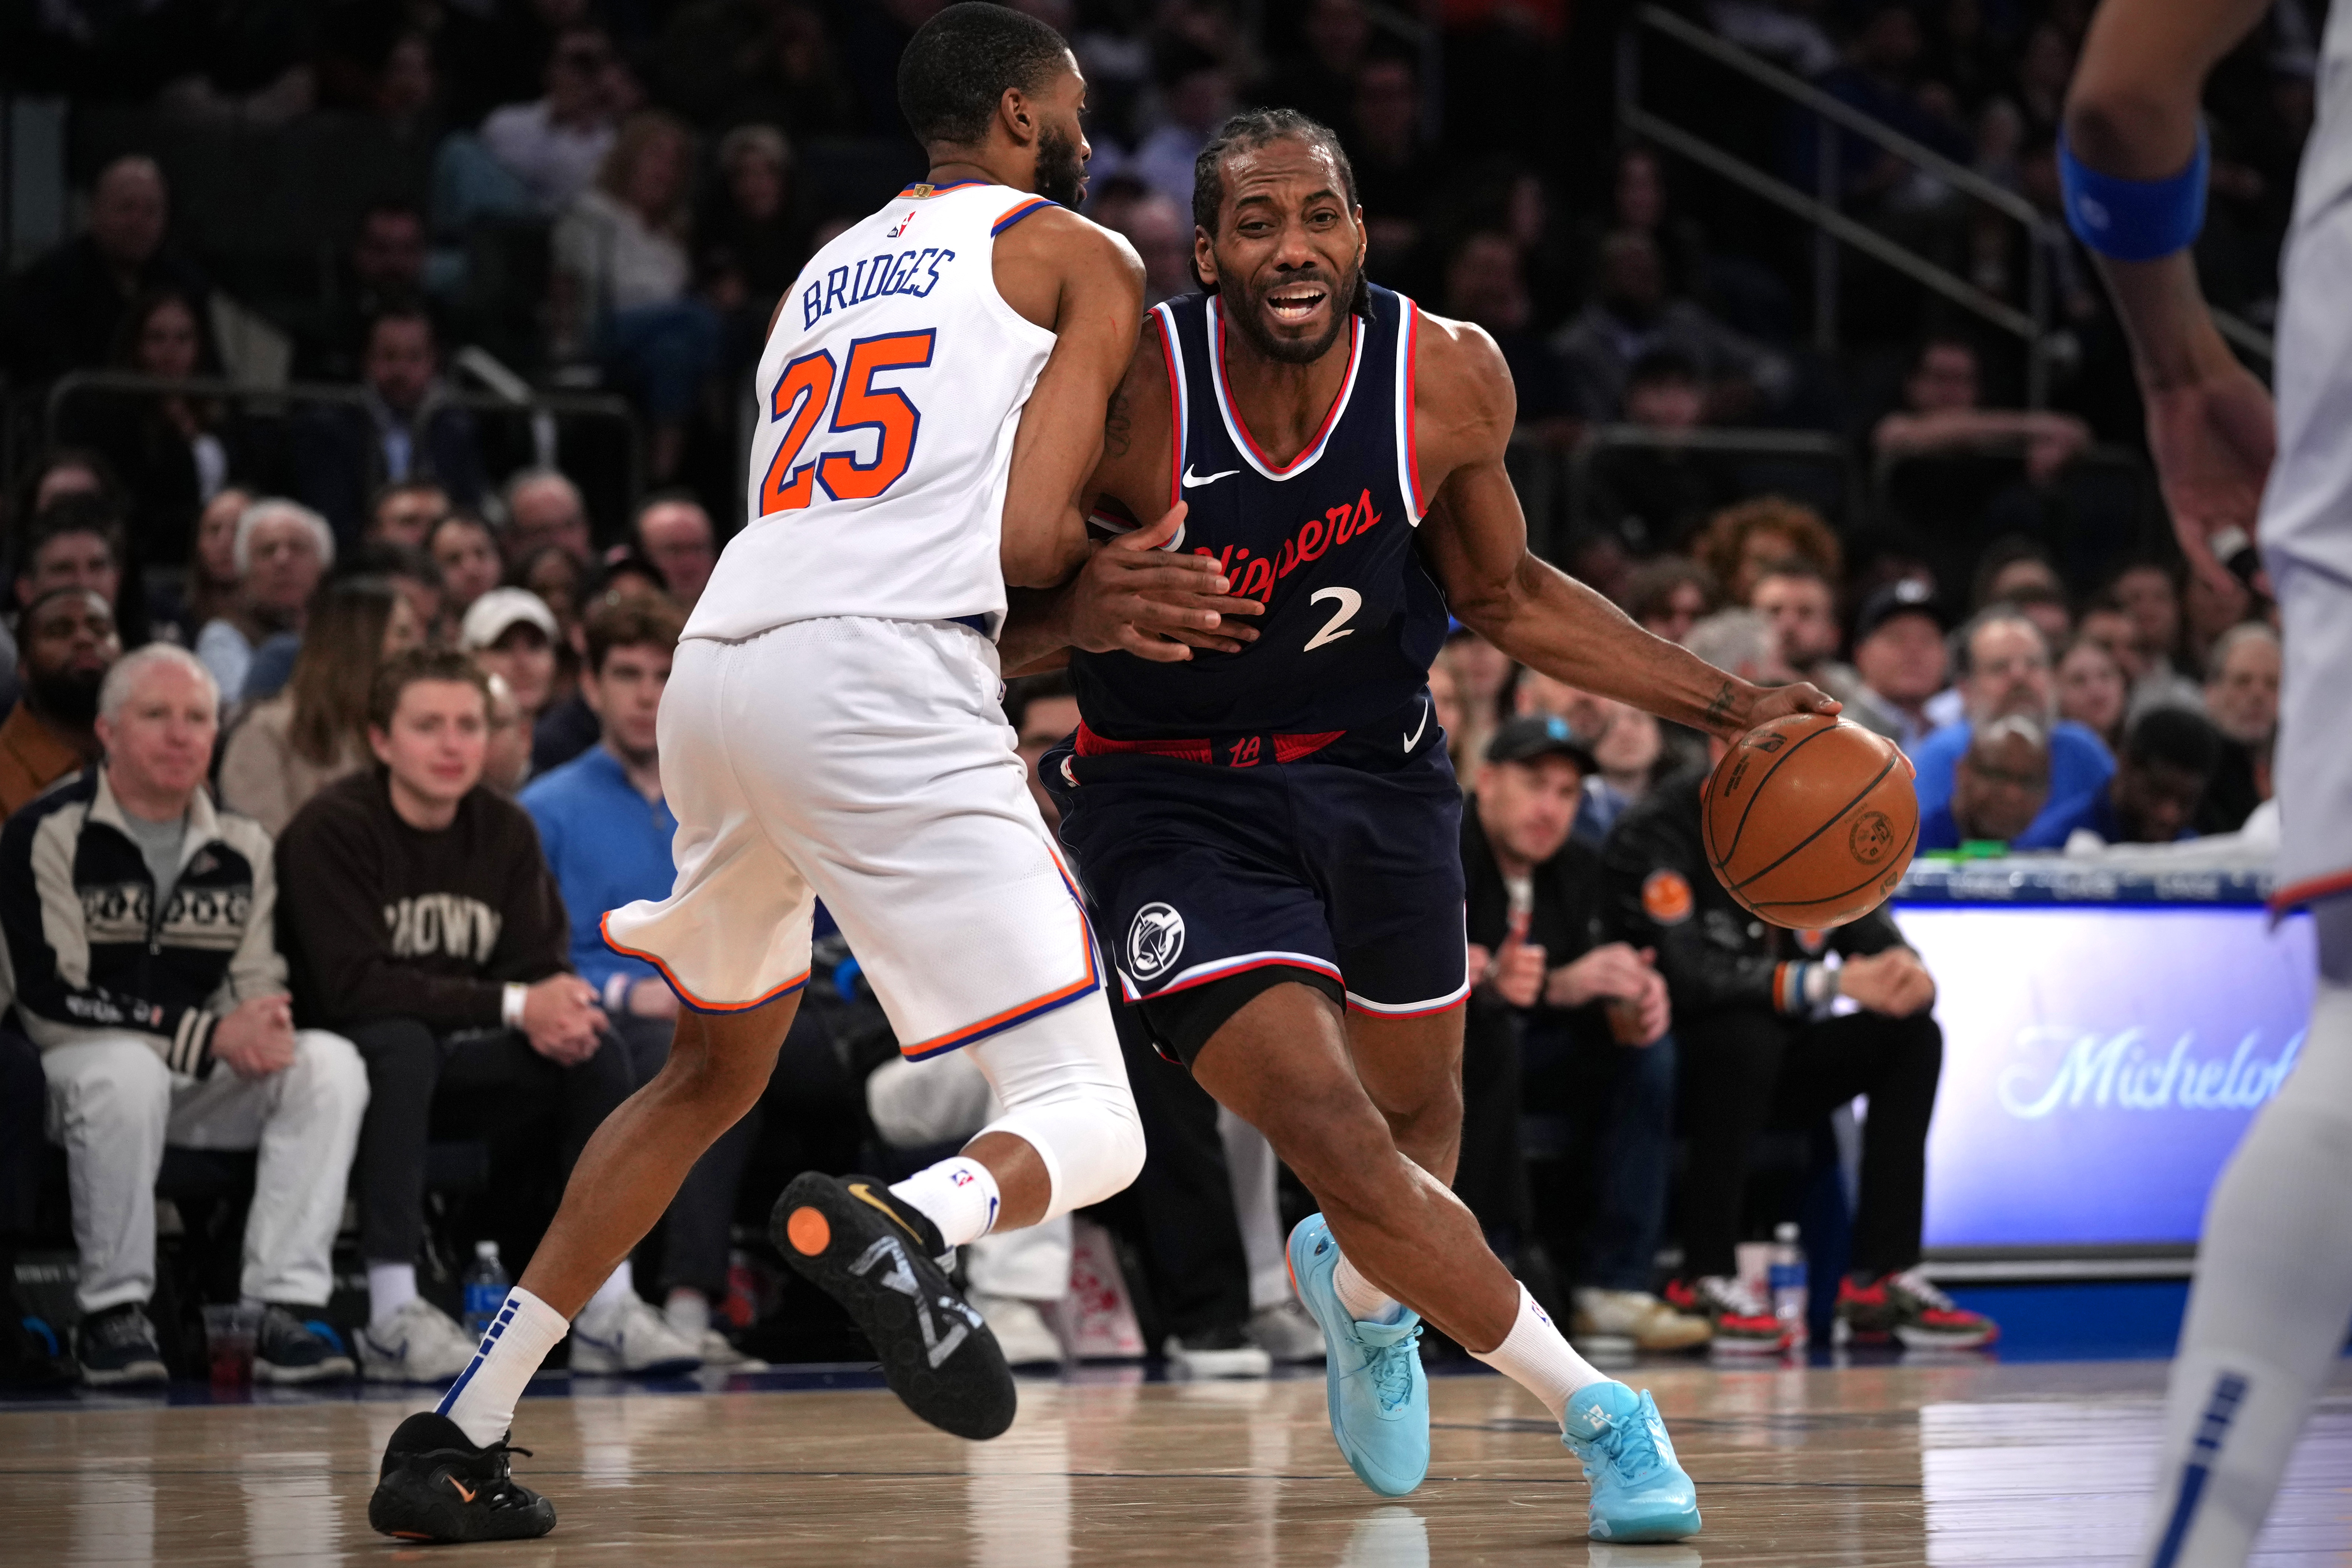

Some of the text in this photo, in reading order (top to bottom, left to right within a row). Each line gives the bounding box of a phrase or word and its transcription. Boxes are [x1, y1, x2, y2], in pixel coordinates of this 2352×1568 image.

[802, 248, 956, 332] BRIDGES
[758, 327, 937, 518] 25
[1193, 488, 1383, 604] lippers
[1303, 586, 1362, 653] 2
[1229, 736, 1260, 767] LA
